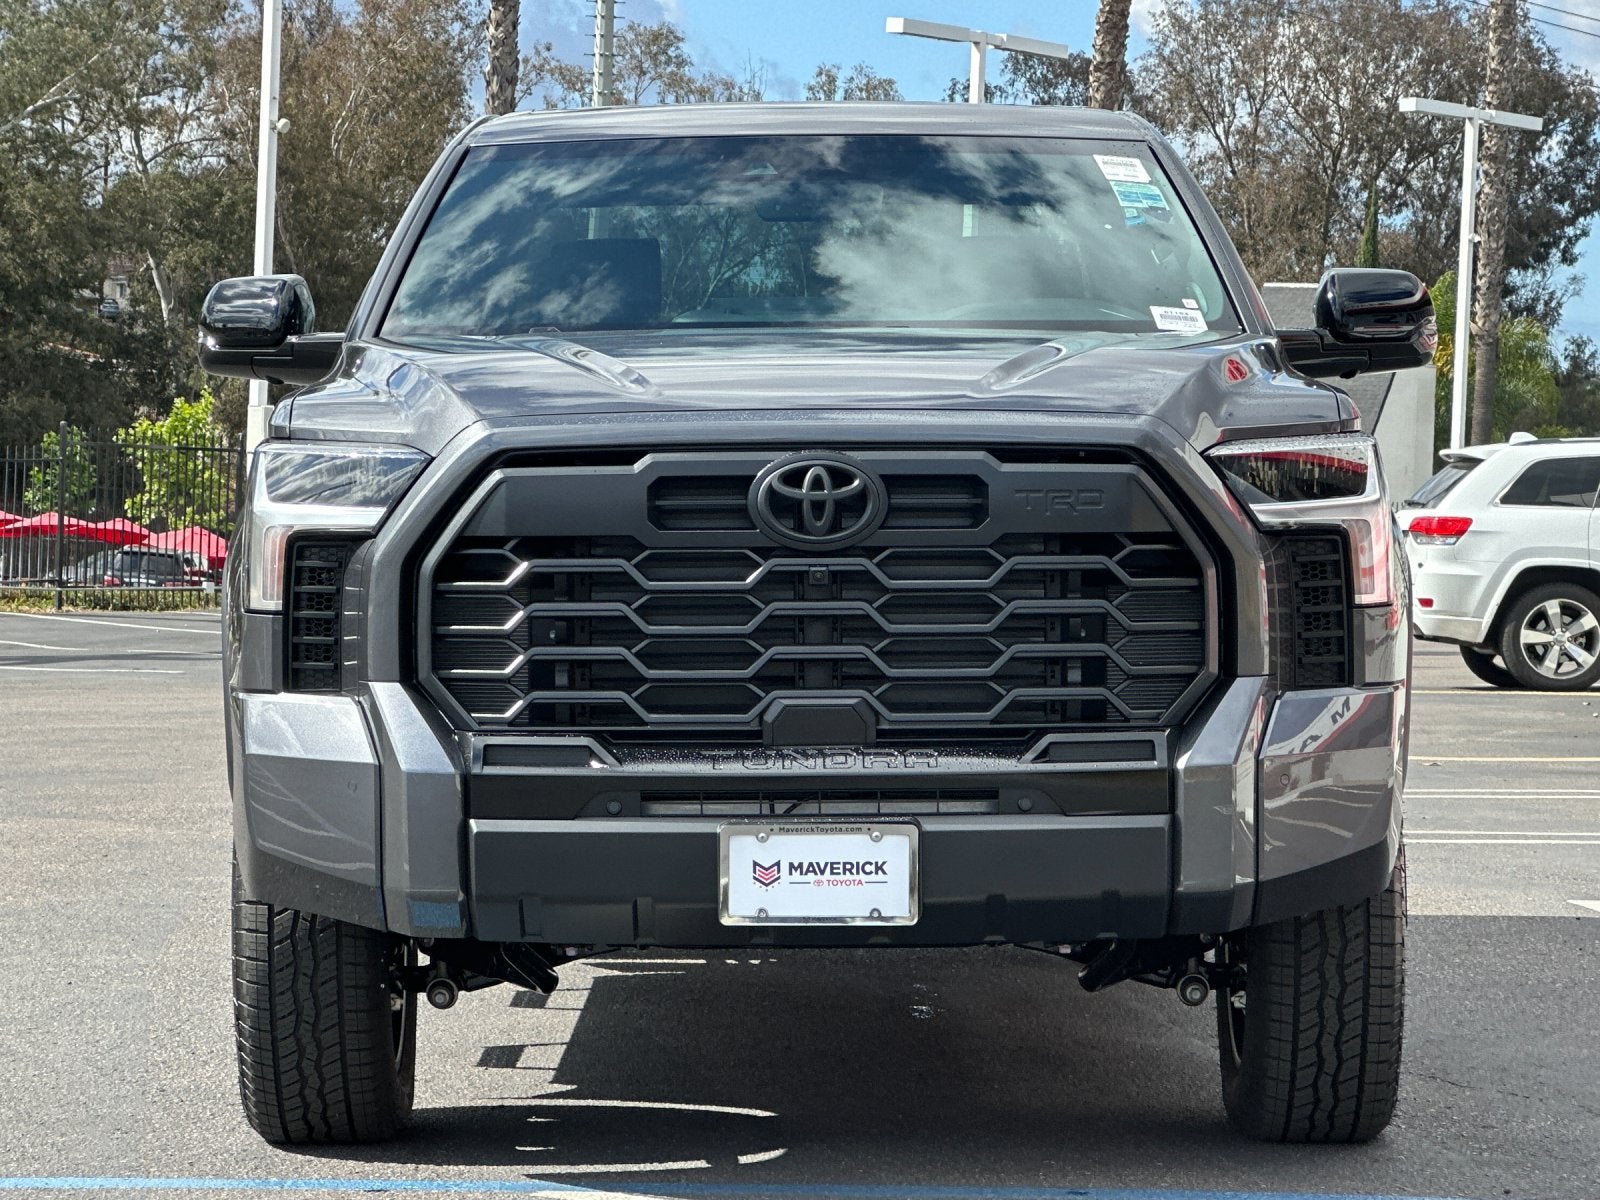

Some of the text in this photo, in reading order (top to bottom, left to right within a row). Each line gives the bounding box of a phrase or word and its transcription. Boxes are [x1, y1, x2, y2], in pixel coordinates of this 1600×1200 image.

[1014, 489, 1105, 515] TRD
[700, 750, 938, 769] TUNDRA
[788, 861, 888, 876] MAVERICK
[826, 879, 864, 887] TOYOTA
